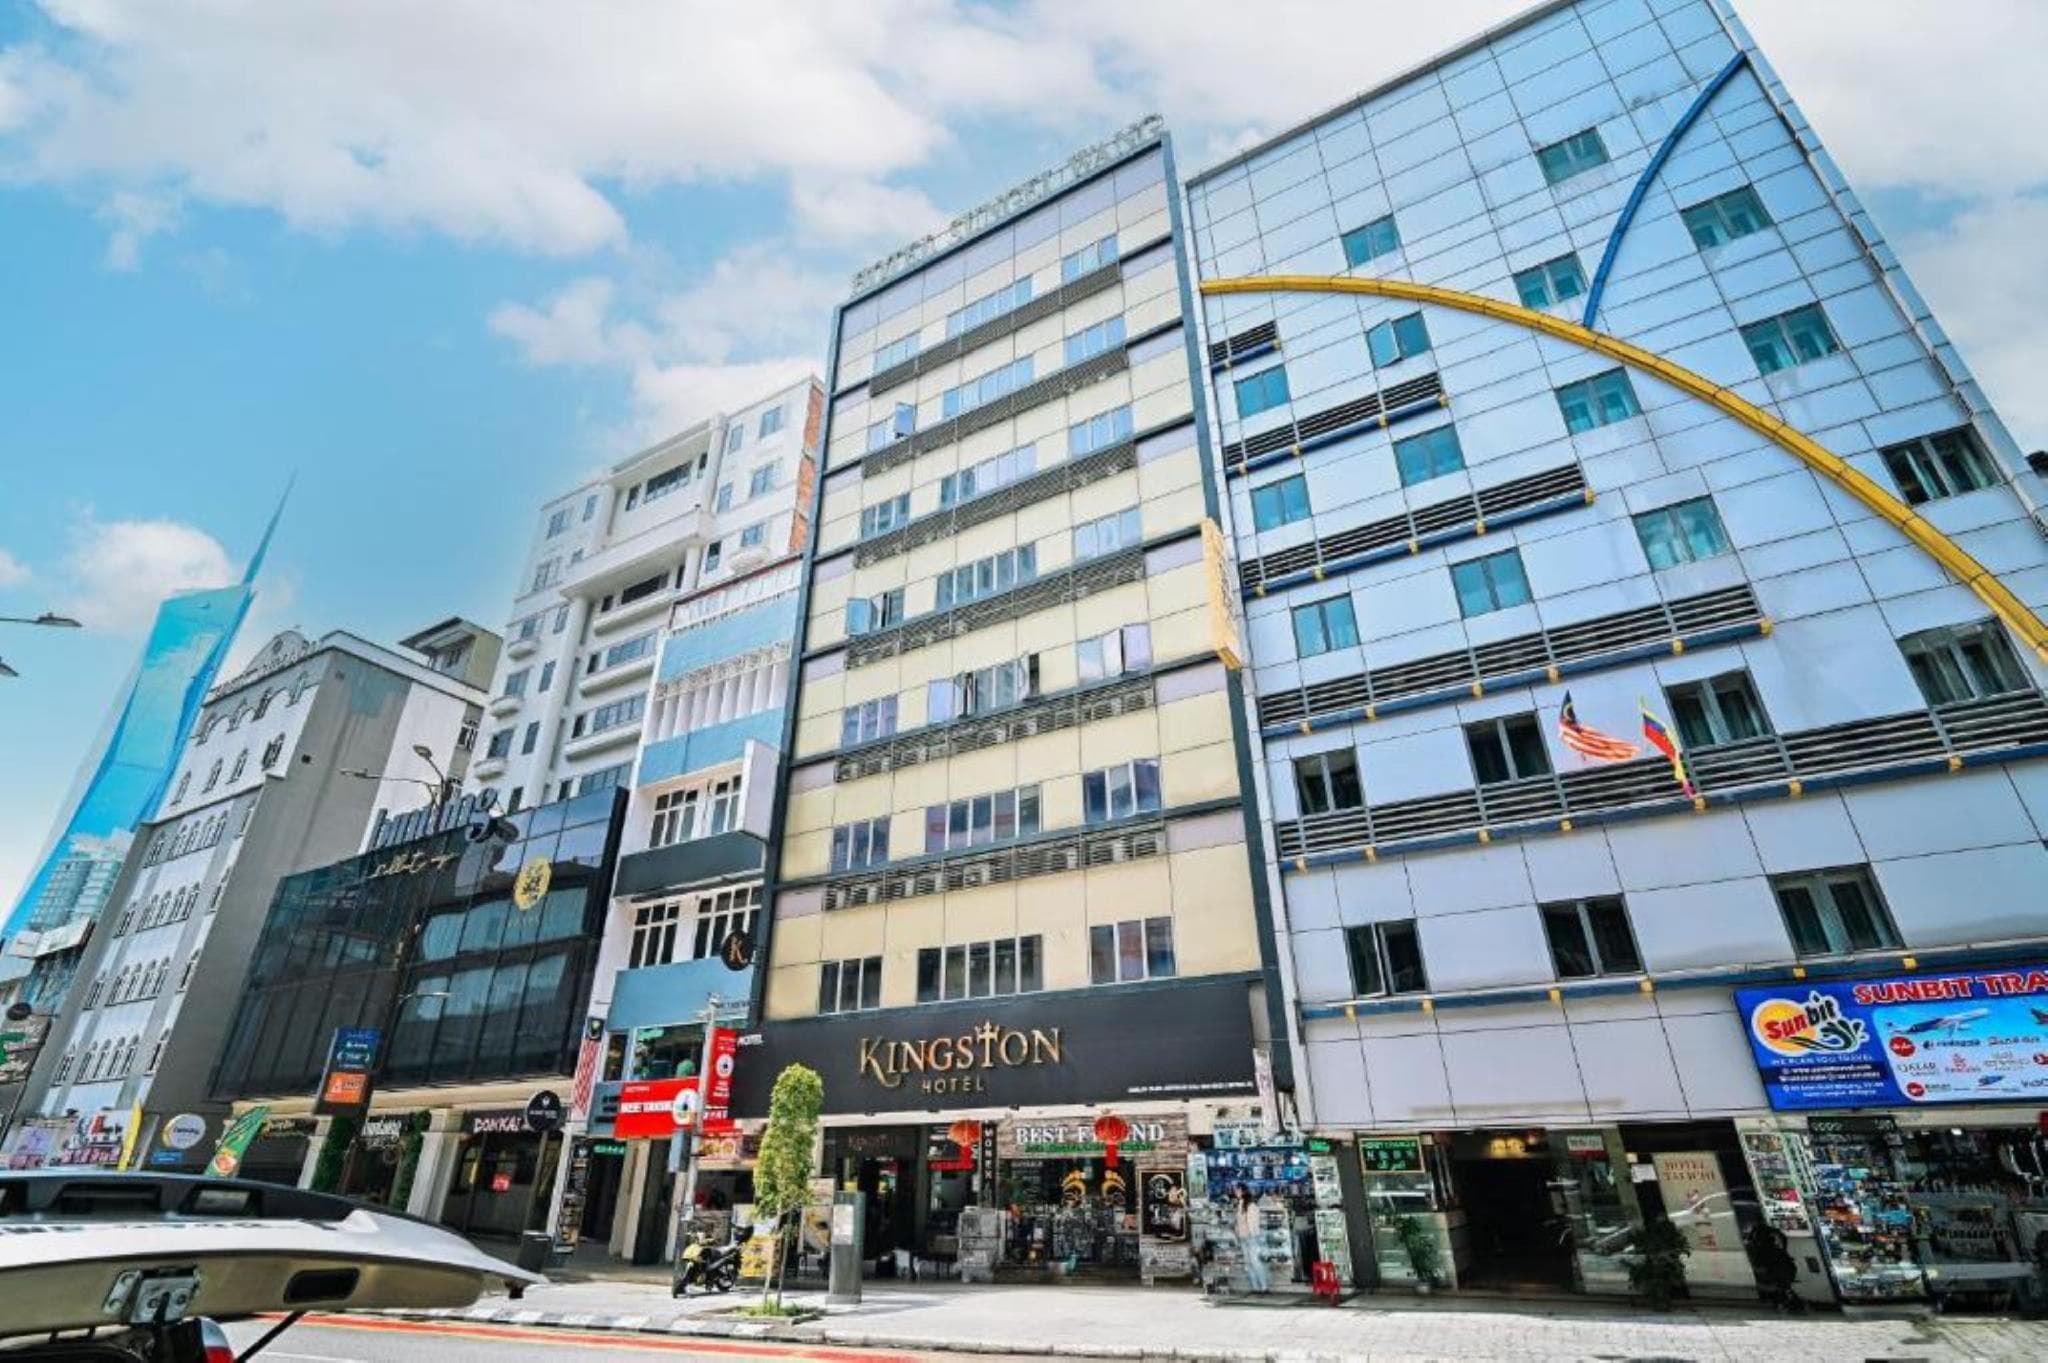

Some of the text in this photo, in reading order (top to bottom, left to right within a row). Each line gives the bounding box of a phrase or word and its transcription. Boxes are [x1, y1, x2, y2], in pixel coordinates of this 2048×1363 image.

[1854, 975, 1974, 1005] SUNBIT
[859, 1019, 1062, 1088] KINGSTON
[922, 1074, 985, 1094] HOTEL
[1016, 1123, 1165, 1145] BEST FND
